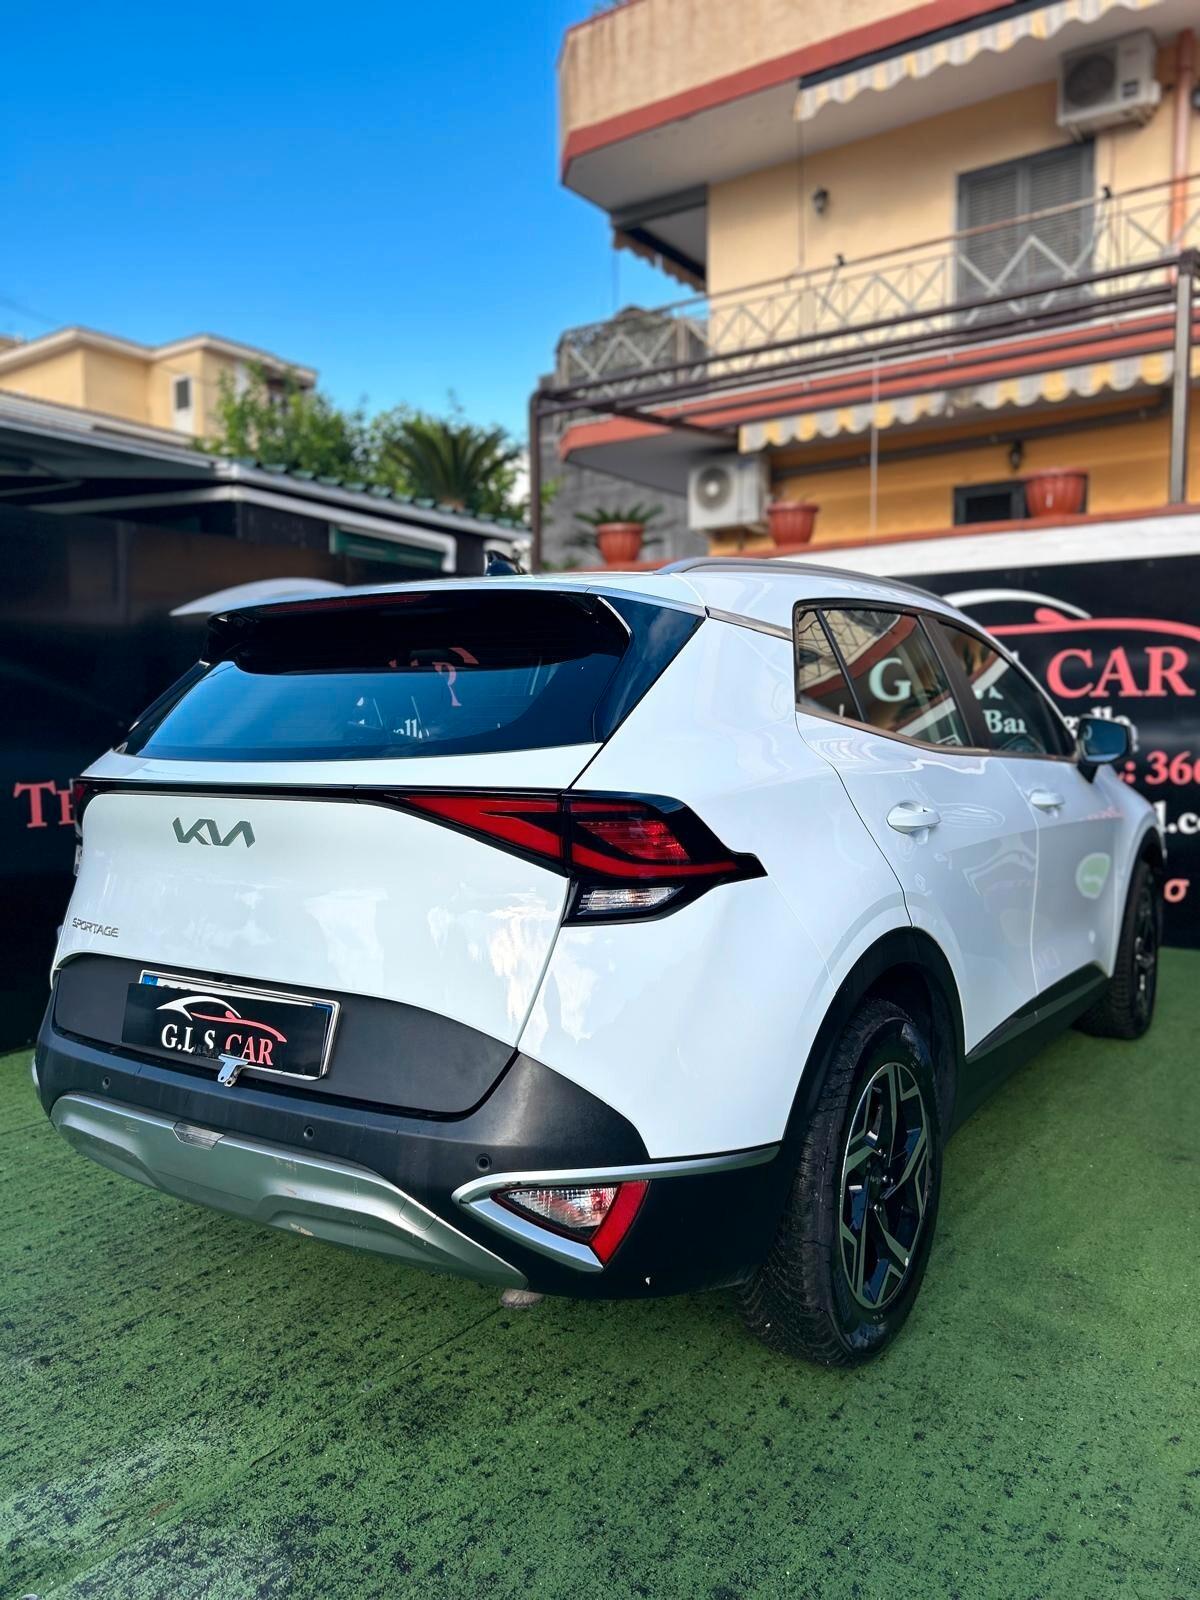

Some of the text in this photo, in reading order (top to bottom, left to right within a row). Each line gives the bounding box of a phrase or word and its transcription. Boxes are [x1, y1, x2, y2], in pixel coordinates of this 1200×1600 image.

[1046, 646, 1196, 699] CAR
[172, 817, 256, 848] KIA
[72, 917, 119, 938] SPORTAGE
[225, 1033, 274, 1067] CAR
